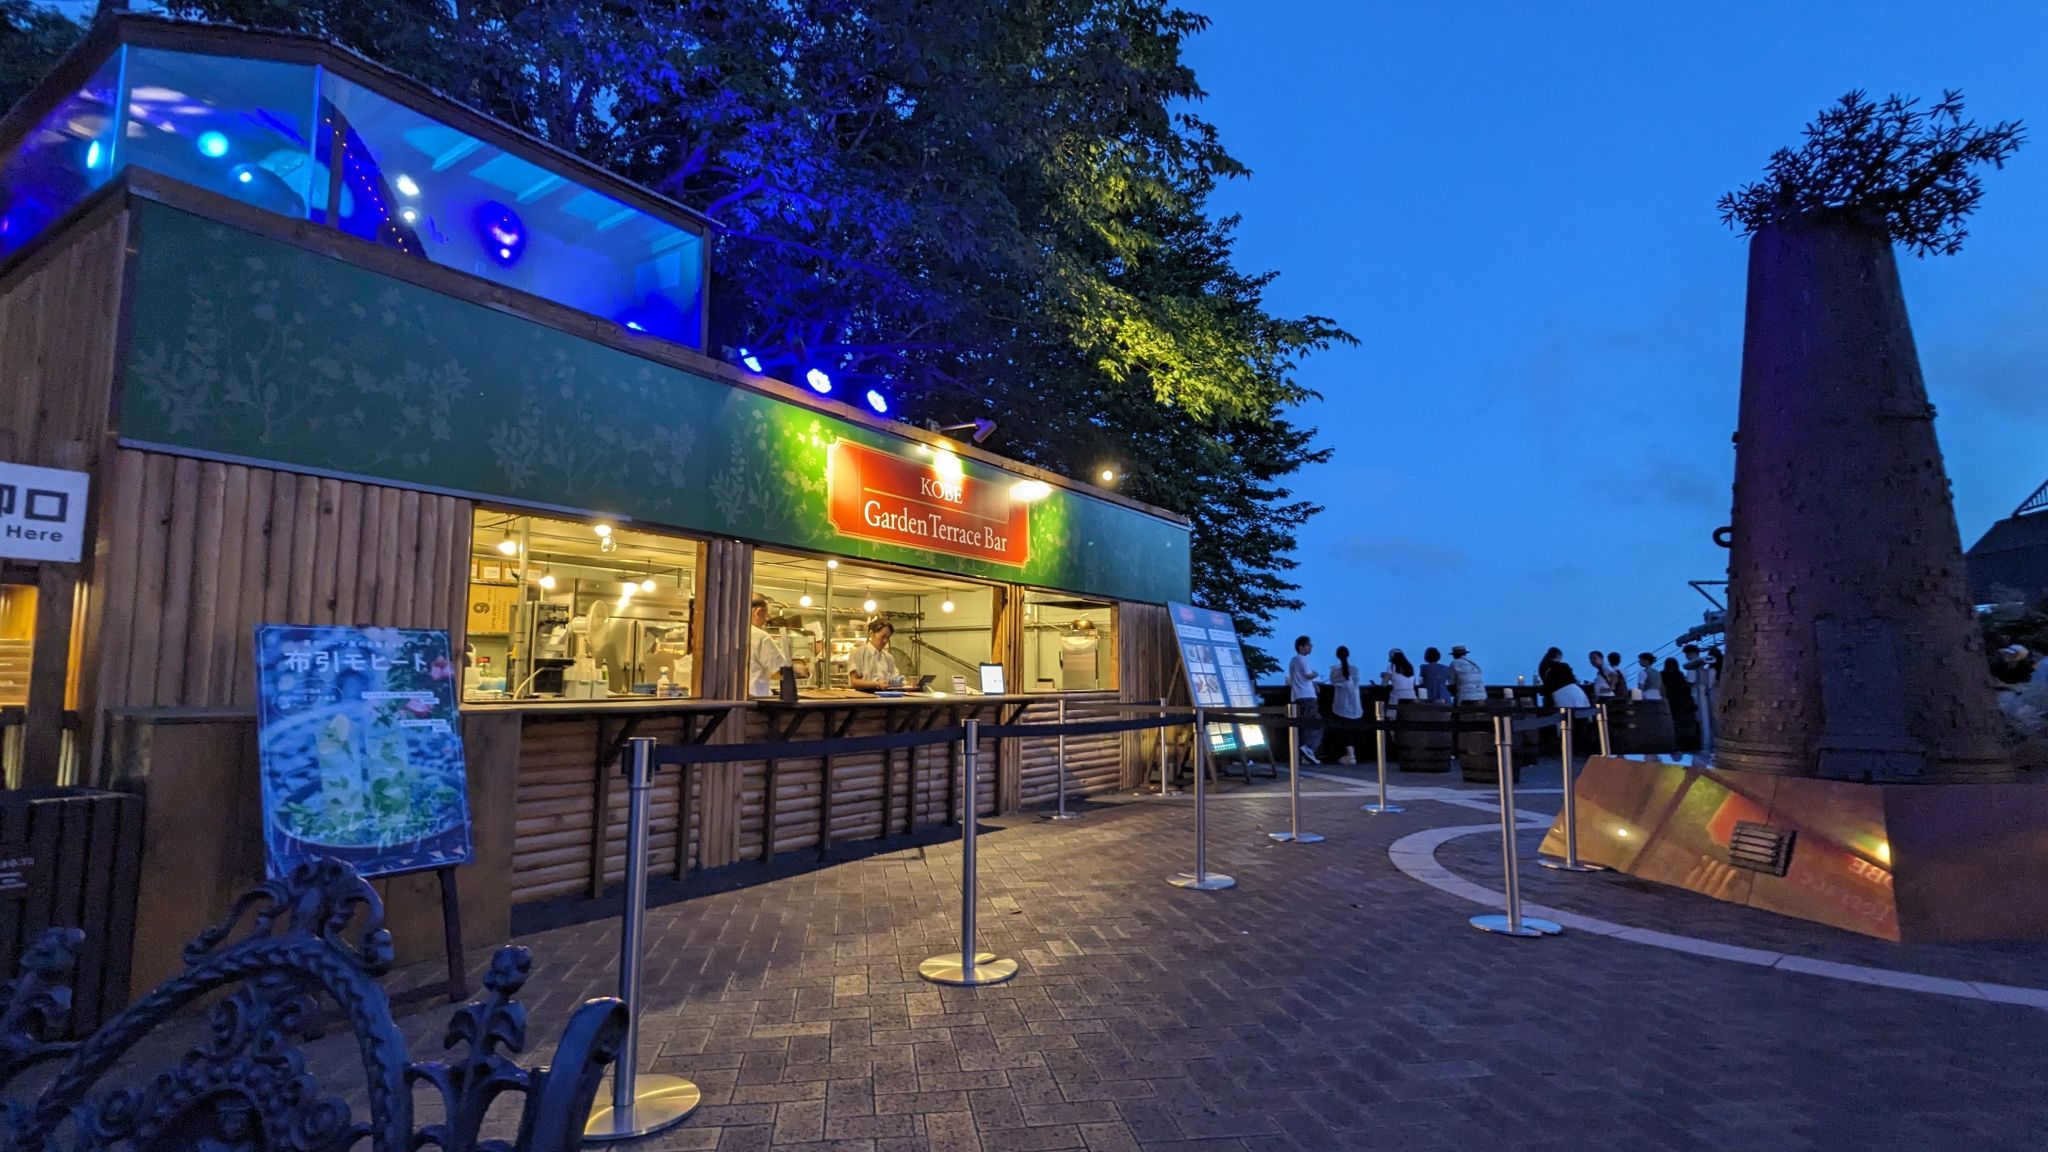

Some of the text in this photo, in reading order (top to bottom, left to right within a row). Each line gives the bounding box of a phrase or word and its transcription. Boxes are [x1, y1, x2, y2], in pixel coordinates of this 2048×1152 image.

[920, 477, 963, 504] KOBE
[6, 524, 64, 542] Here
[864, 500, 1008, 552] Garden Terrace Bar
[284, 650, 428, 673] 布引モヒート
